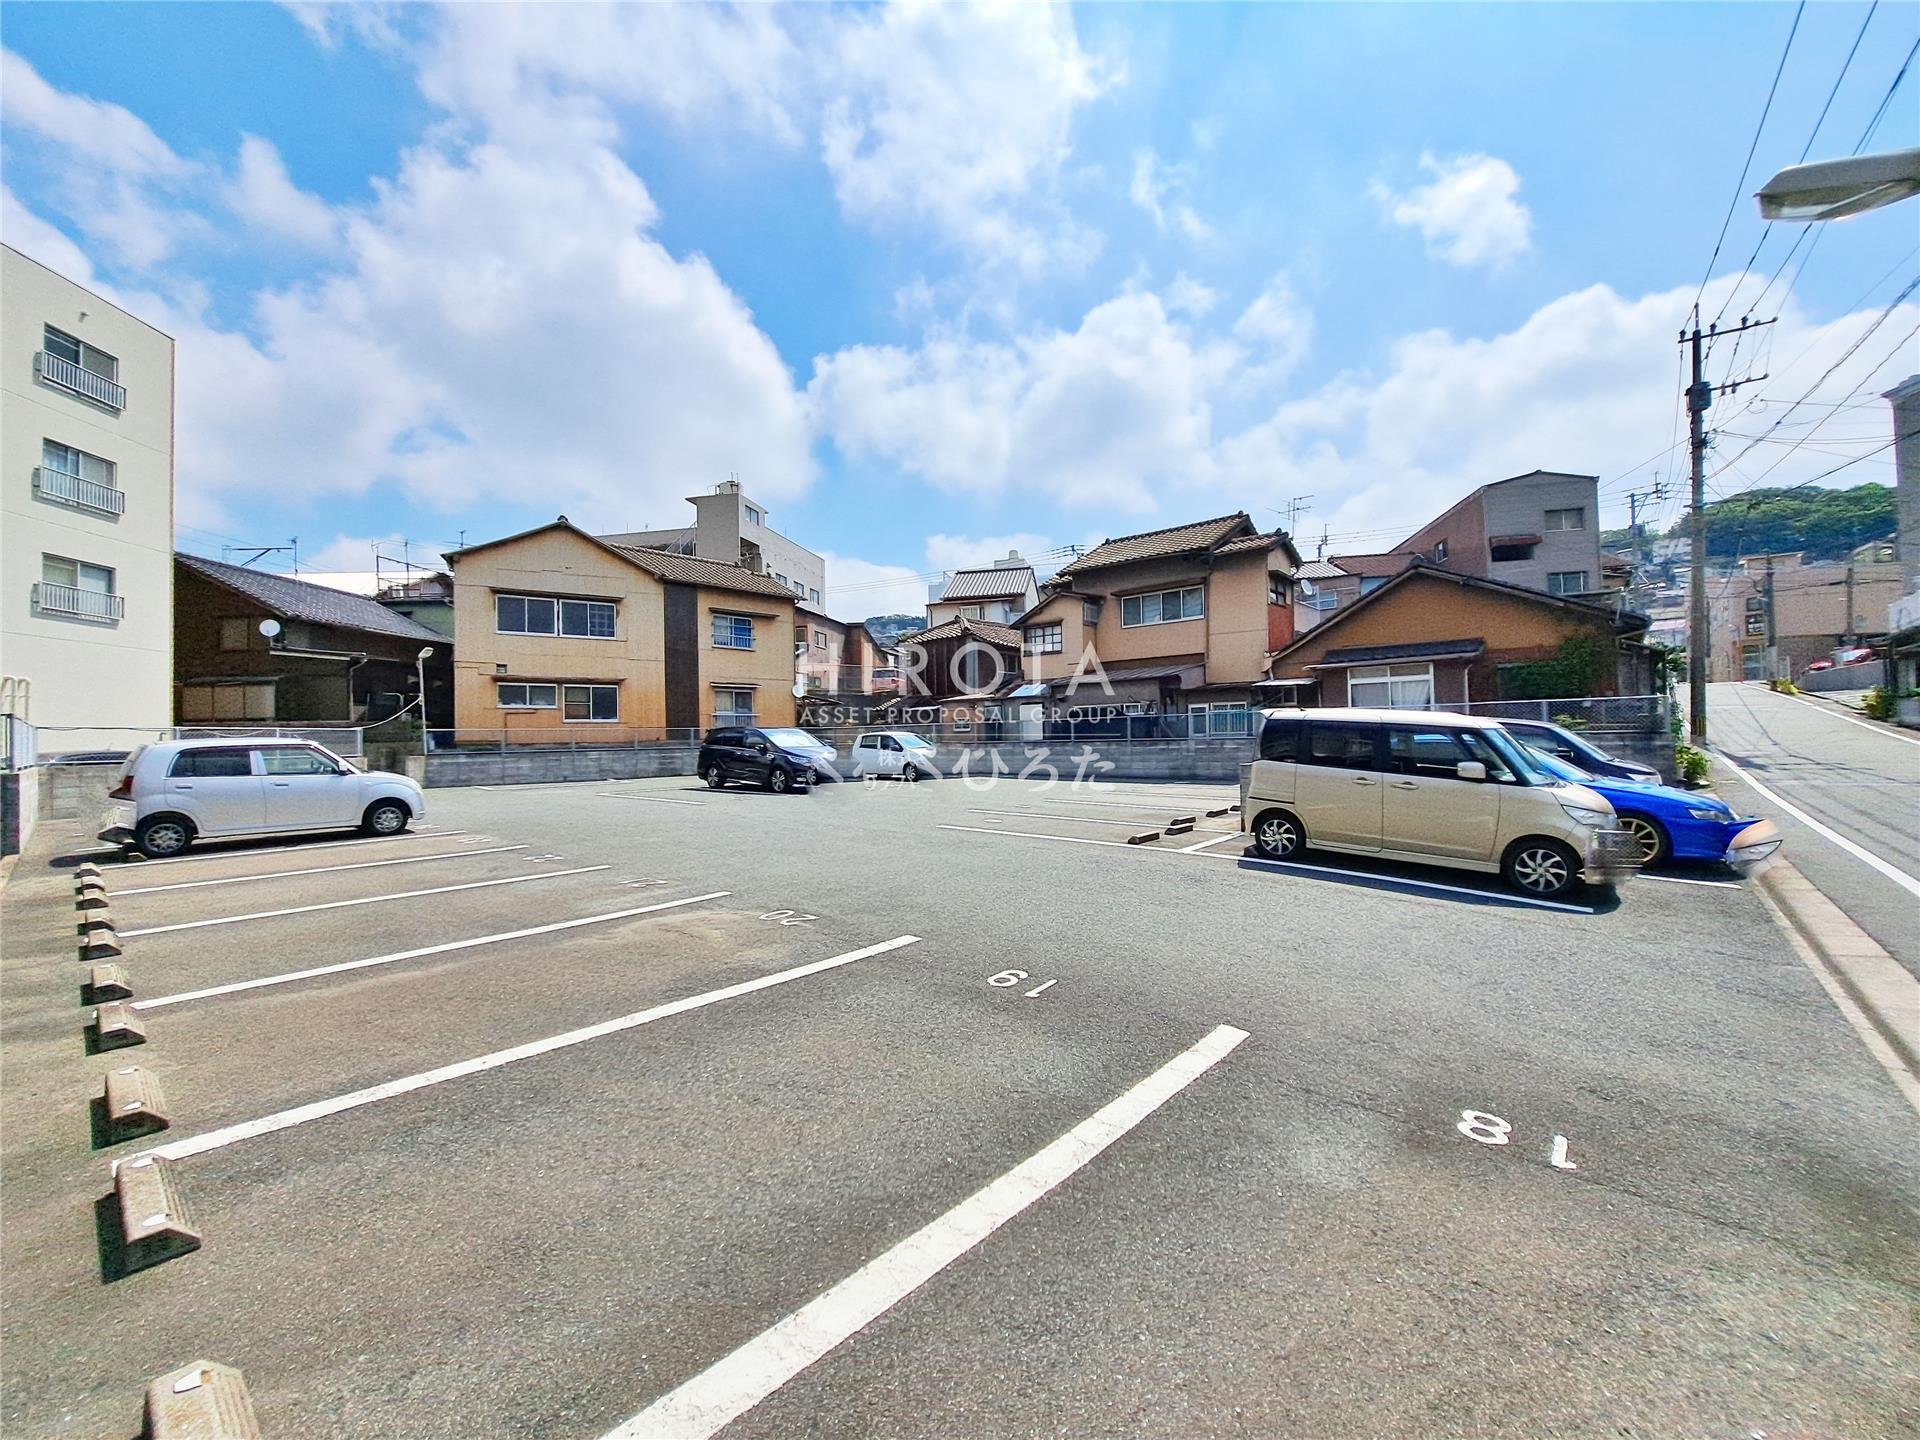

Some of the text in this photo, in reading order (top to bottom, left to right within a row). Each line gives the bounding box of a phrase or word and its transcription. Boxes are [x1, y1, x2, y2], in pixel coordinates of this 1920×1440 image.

[758, 909, 820, 927] 20
[987, 969, 1059, 998] 19
[1456, 1109, 1577, 1169] 18
